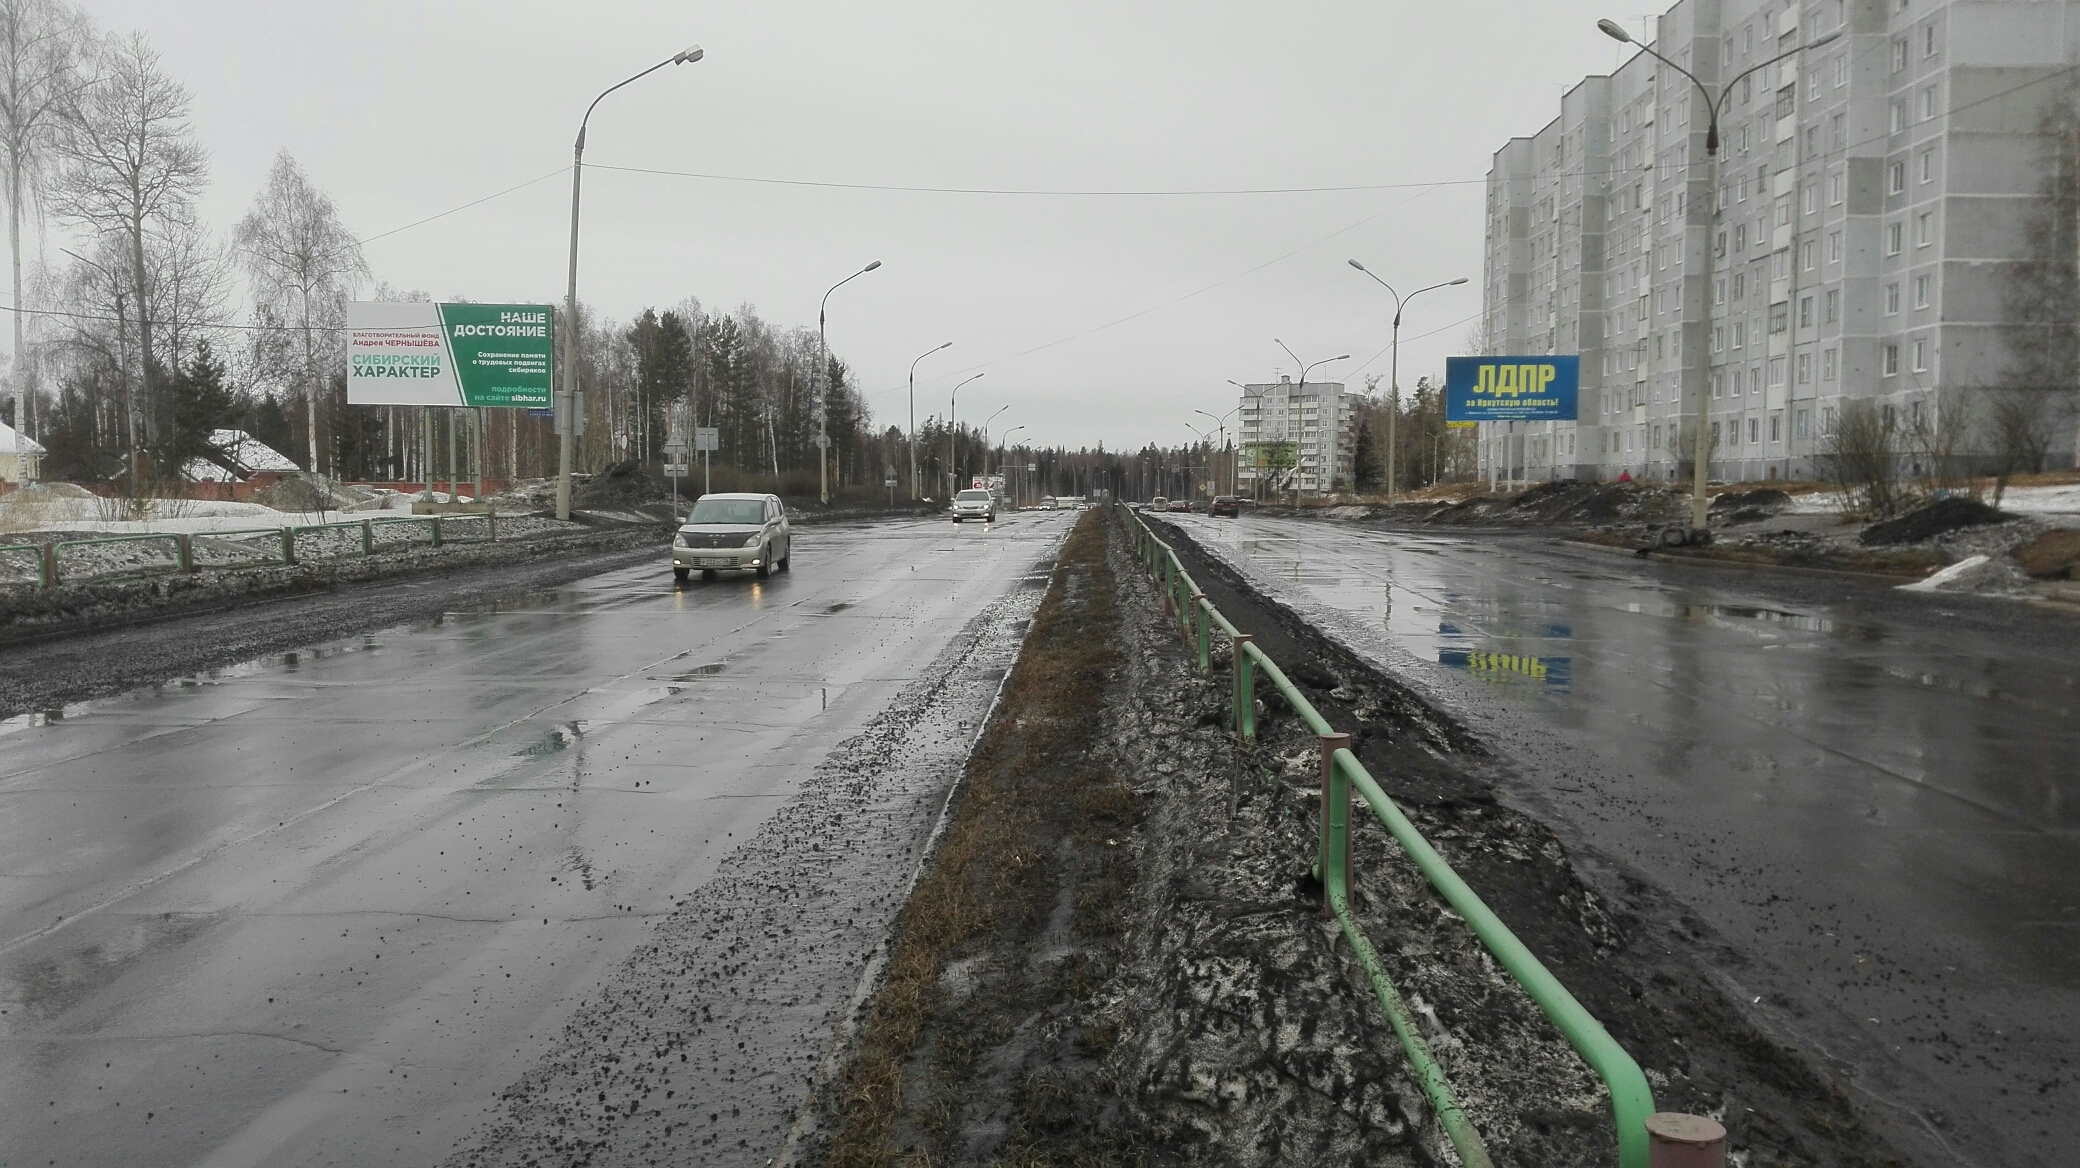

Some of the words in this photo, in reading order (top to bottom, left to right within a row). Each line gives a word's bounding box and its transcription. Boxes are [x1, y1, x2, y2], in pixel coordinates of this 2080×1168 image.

[500, 312, 546, 323] НАШЕ
[454, 324, 546, 337] ДОСТОЯНИЕ
[352, 339, 383, 347] Андрея
[385, 339, 440, 347] ЧЕРНЫШЁВА
[352, 353, 441, 366] СИБИРСКИЙ
[477, 351, 520, 359] Сохранение
[352, 365, 441, 378] ХАРАКТЕР
[1473, 364, 1556, 398] ЛДПР
[511, 394, 546, 402] sibhar.ru
[1477, 399, 1521, 407] Иркутскую
[1522, 398, 1559, 406] область!
